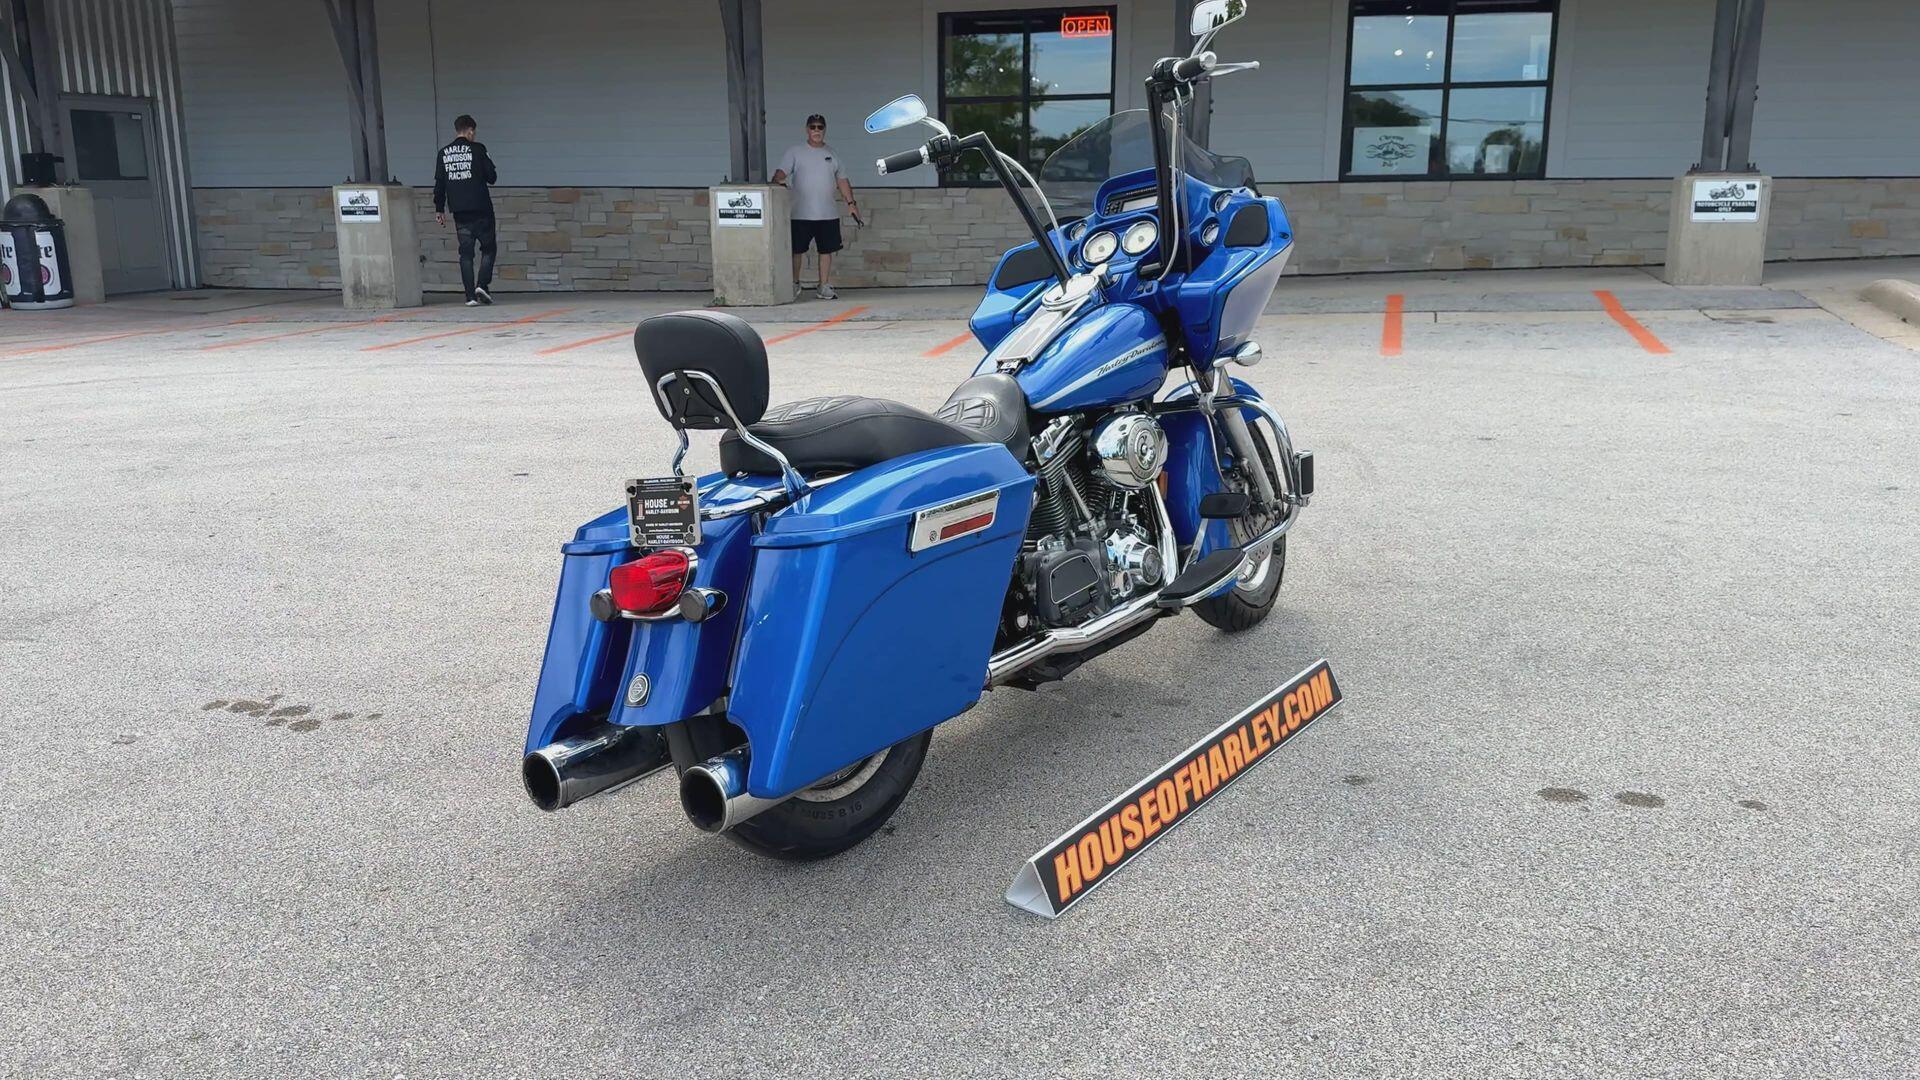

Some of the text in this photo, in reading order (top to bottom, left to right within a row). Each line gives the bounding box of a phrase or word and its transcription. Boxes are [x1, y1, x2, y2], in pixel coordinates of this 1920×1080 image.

[1065, 20, 1107, 34] OPEN
[443, 145, 472, 156] HARLEY-
[442, 153, 473, 164] DAVIDSON
[445, 162, 472, 173] FACTORY
[449, 170, 472, 180] RACING
[644, 498, 668, 509] HOUSE
[1054, 668, 1334, 903] HOUSEOFHARLEY.COM
